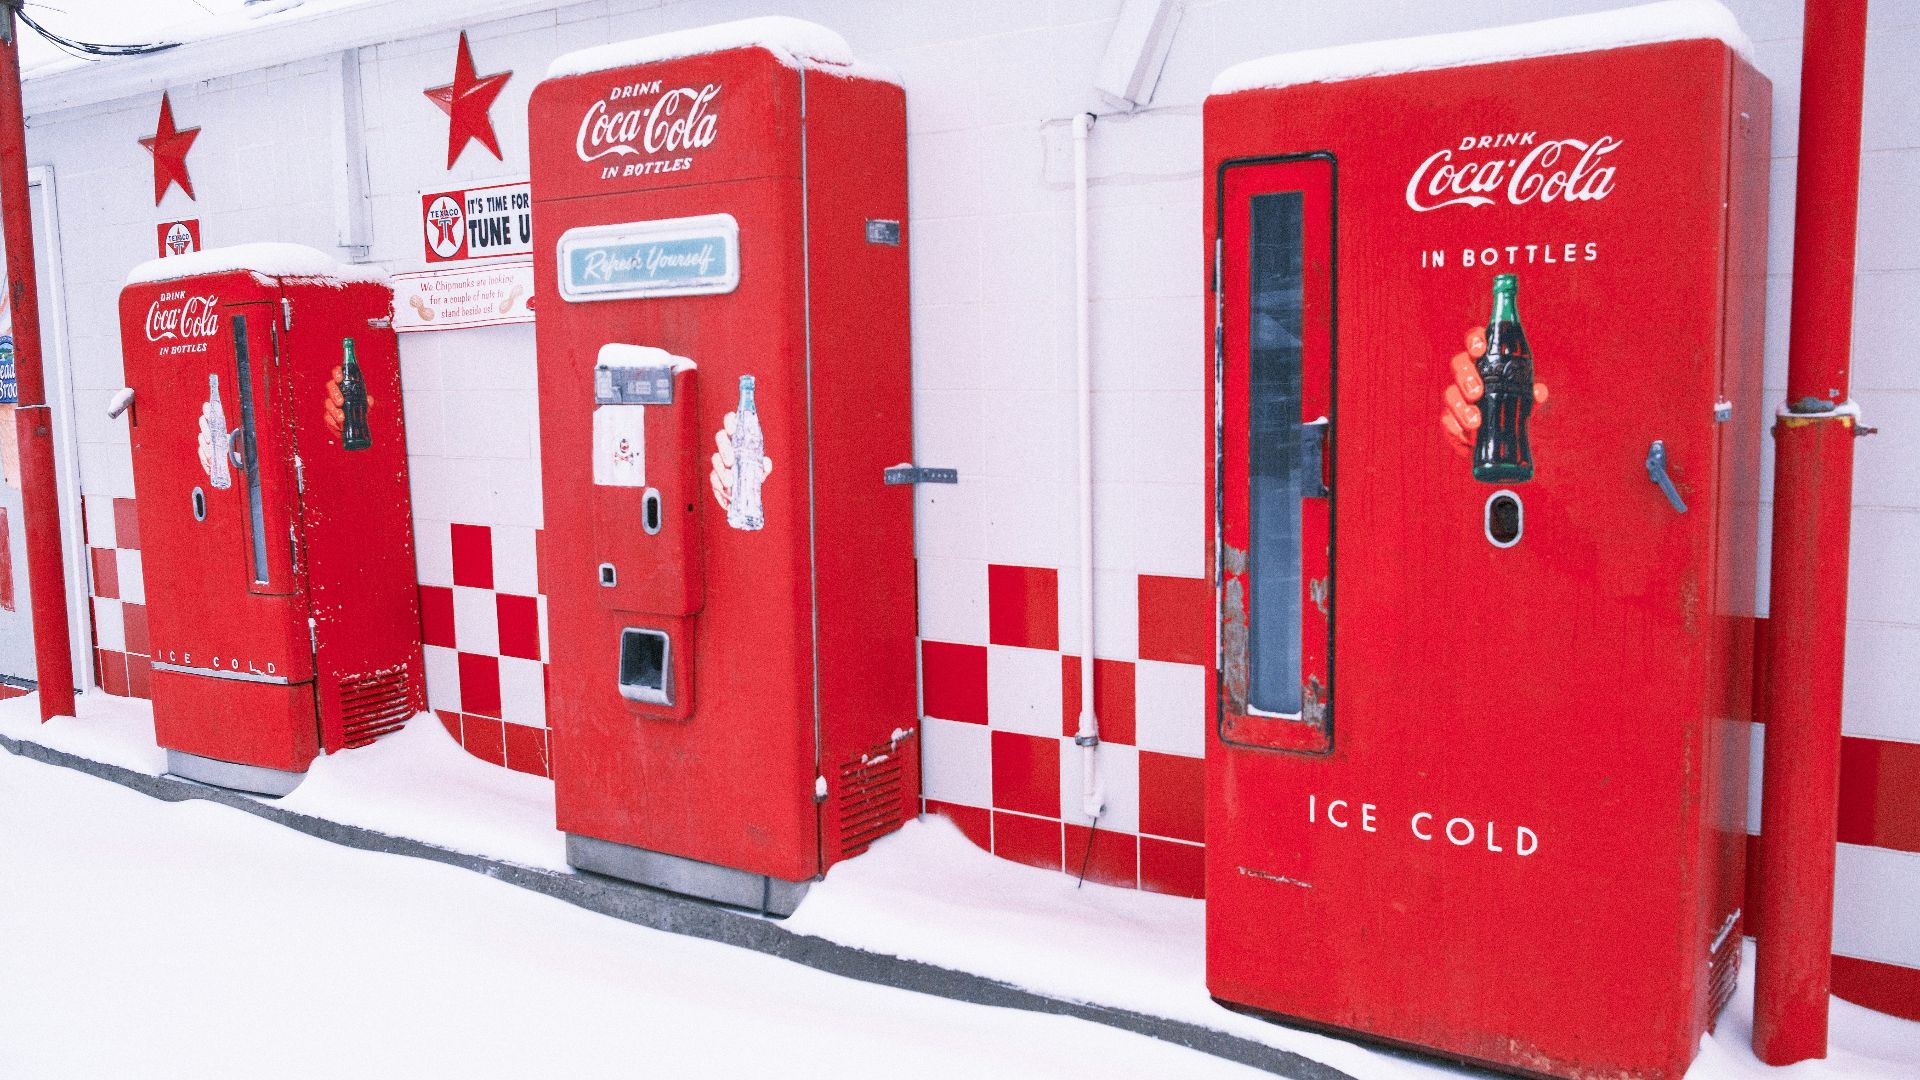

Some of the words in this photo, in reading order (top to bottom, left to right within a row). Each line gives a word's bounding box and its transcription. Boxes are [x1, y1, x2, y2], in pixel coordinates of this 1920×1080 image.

[610, 80, 662, 100] DRINK
[576, 83, 722, 162] Coca-Cola
[1458, 131, 1537, 151] DRINK
[601, 165, 618, 179] IN
[623, 157, 693, 176] BOTTLES
[1406, 136, 1623, 212] Coca-Cola
[430, 208, 459, 219] TEXACO
[467, 197, 483, 215] IT'S
[486, 195, 508, 213] TIME
[512, 192, 530, 210] FOR
[168, 234, 190, 242] TEXACO
[468, 216, 512, 248] TUNE
[518, 214, 531, 244] U
[583, 249, 642, 281] Refresh
[646, 244, 715, 276] Yourself
[1422, 250, 1445, 268] IN
[1462, 242, 1598, 267] BOTTLES
[160, 290, 186, 302] DRINK
[420, 282, 433, 292] We
[436, 279, 474, 292] Chipmunks
[430, 294, 441, 305] for
[450, 292, 471, 304] couple
[145, 294, 218, 342] Coca-Cola
[441, 307, 460, 318] stand
[462, 306, 482, 316] beside
[160, 347, 168, 356] IN
[170, 342, 208, 355] BOTTLES
[0, 357, 16, 380] ead
[158, 650, 191, 664] ICE
[213, 656, 276, 674] COLD
[1308, 794, 1377, 832] ICE
[1410, 812, 1538, 857] COLD
